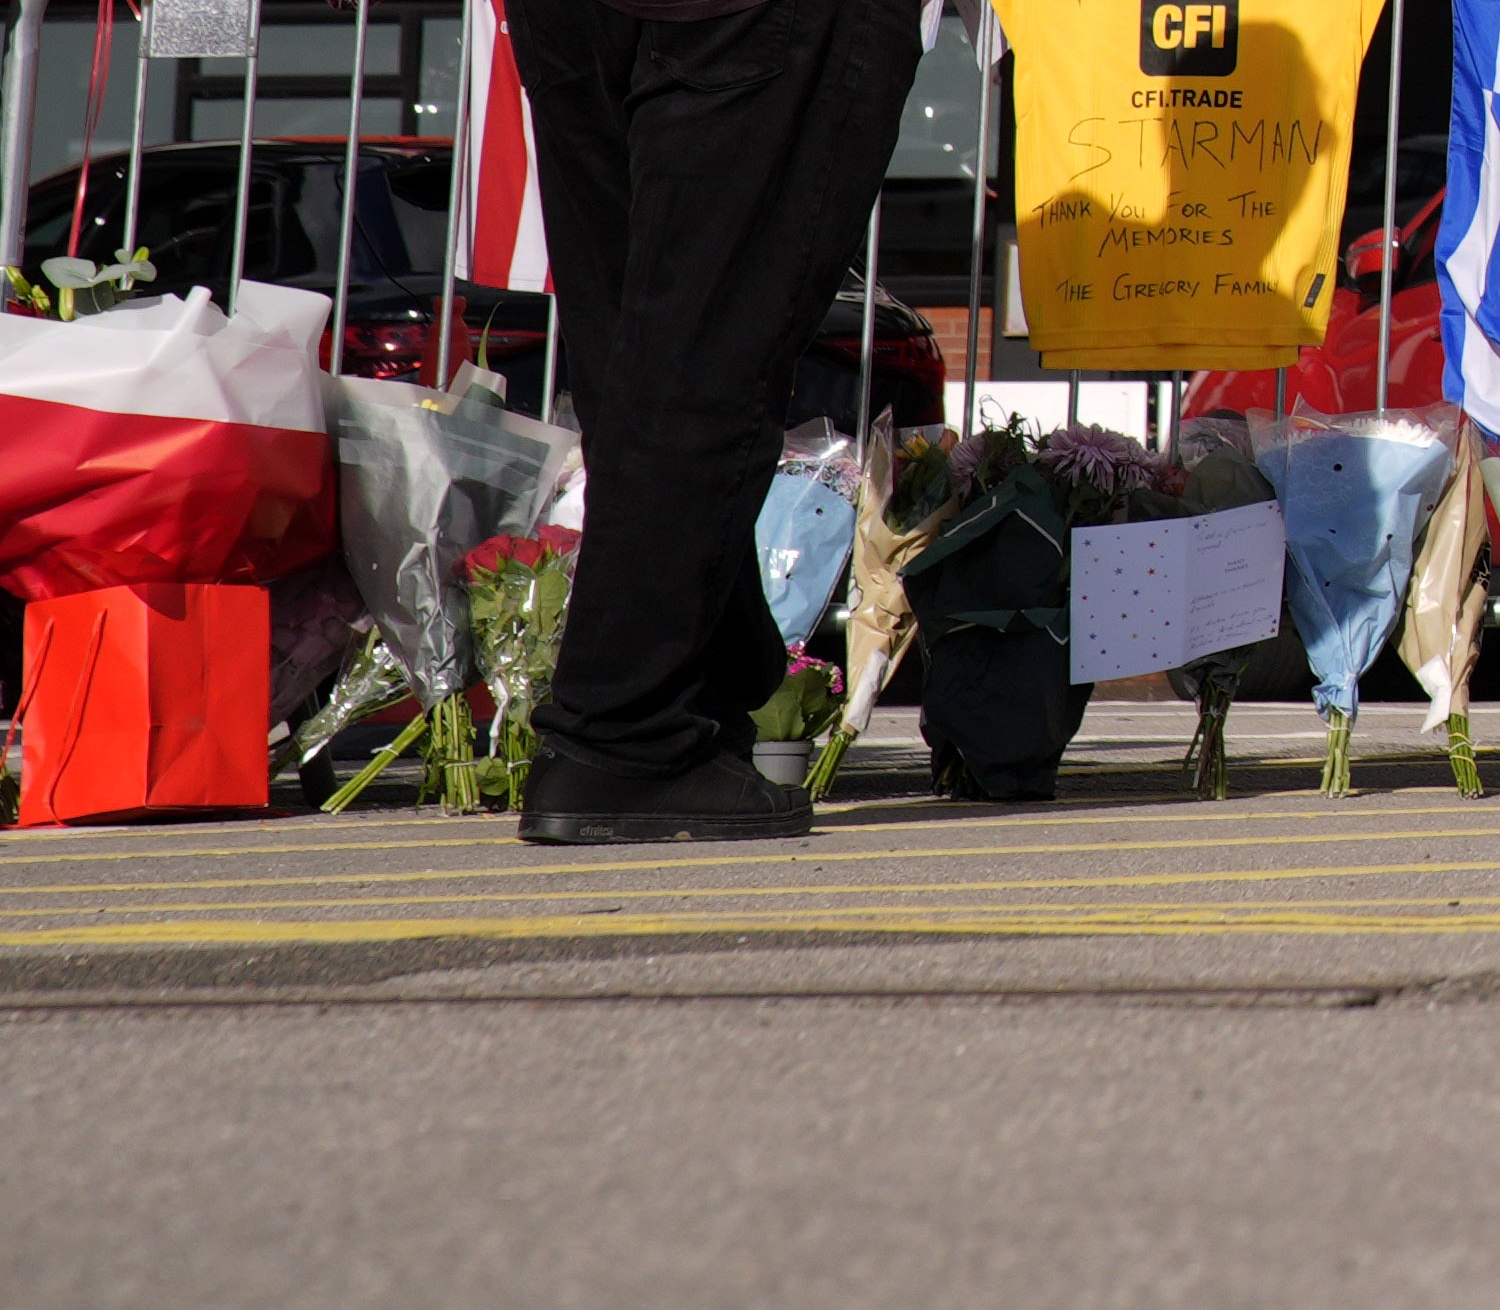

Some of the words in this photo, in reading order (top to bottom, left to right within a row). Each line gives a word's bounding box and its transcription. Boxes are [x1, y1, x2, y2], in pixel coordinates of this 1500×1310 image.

[1151, 4, 1227, 50] CFI
[1130, 88, 1244, 109] CFI.TRADE
[1067, 117, 1325, 183] STARMAN
